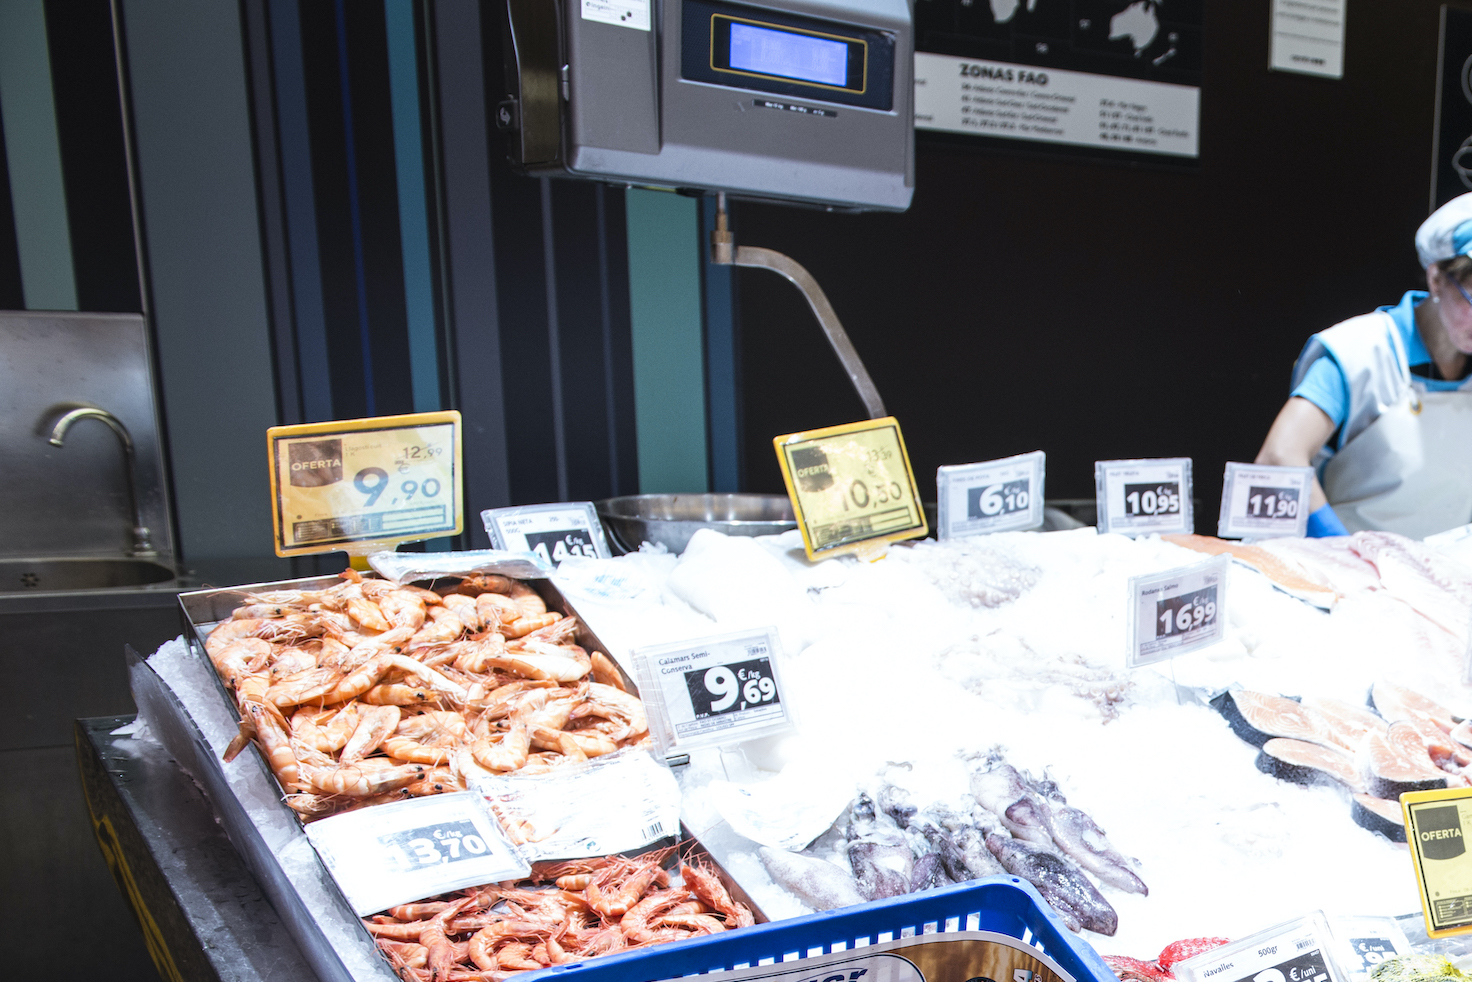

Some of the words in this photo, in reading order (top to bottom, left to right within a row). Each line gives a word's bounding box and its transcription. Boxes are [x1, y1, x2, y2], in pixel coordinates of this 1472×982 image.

[291, 459, 342, 471] OFERTA
[797, 464, 829, 478] OFERTA
[353, 466, 441, 507] 9,90
[980, 484, 1028, 515] 6,10
[1126, 490, 1179, 516] 10,95
[1250, 494, 1297, 519] 11,90
[1160, 602, 1216, 635] 16,99
[659, 654, 690, 666] Calamars
[691, 651, 711, 660] Semi-
[661, 664, 692, 675] Conserva
[703, 666, 776, 711] 9,69
[1421, 828, 1462, 842] OFERTA
[386, 835, 487, 870] 13,70
[1203, 961, 1234, 978] Navalles
[1258, 945, 1278, 958] 500gr
